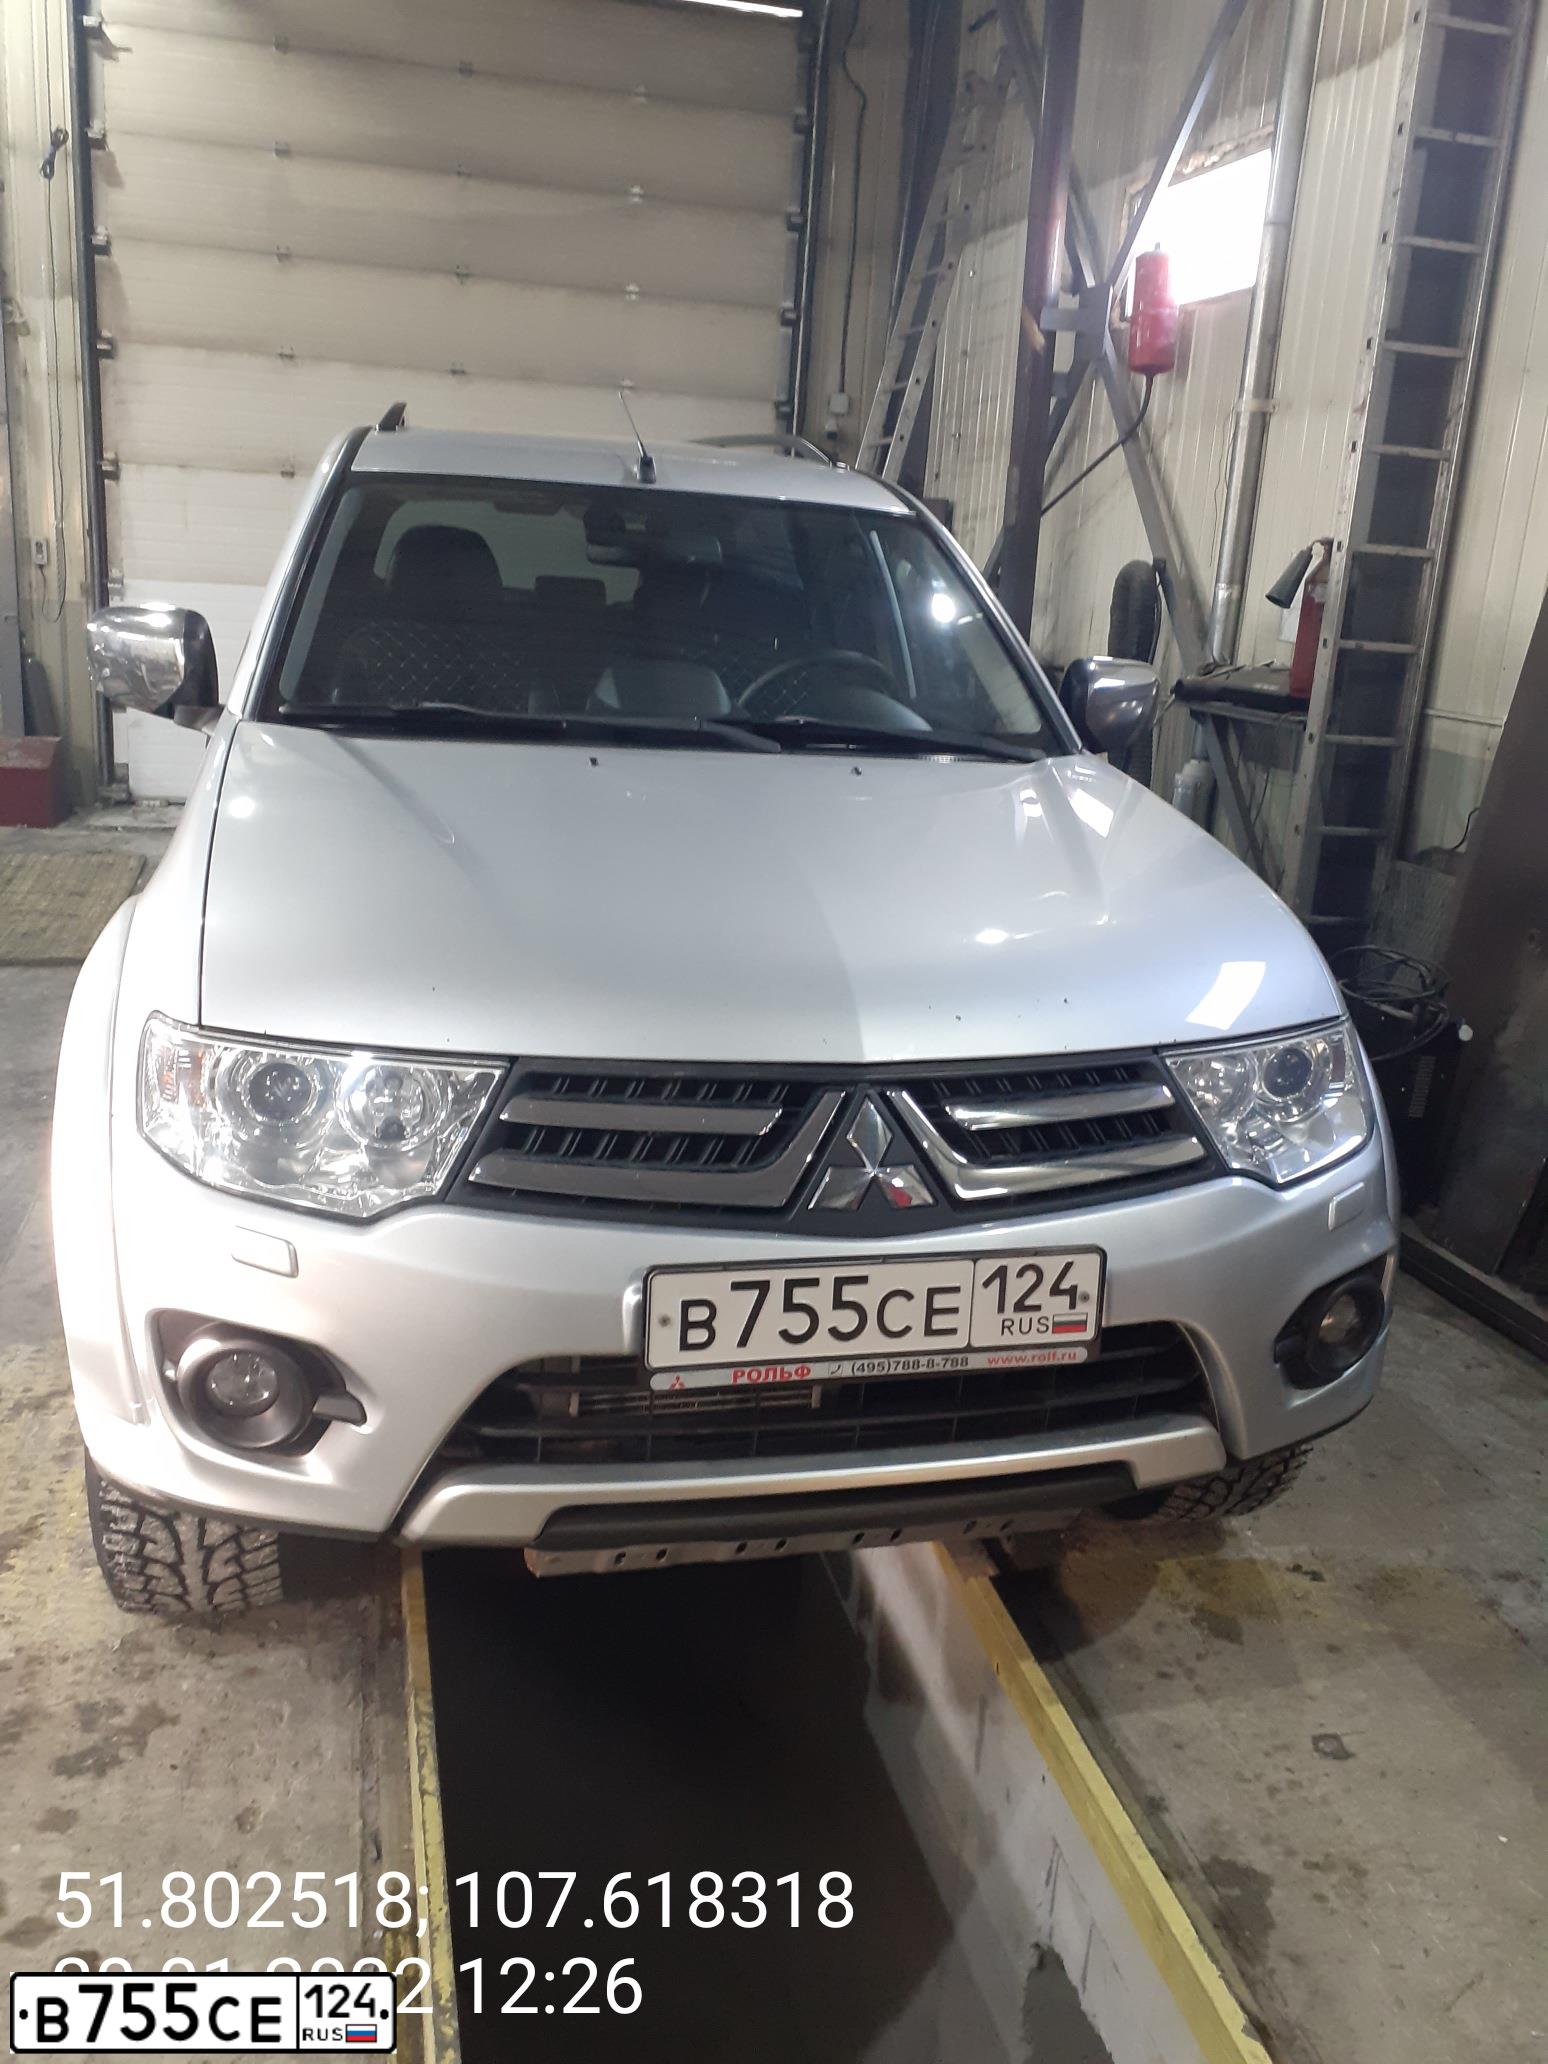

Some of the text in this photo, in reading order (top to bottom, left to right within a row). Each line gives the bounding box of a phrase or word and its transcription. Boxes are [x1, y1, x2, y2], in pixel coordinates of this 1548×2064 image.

[982, 1261, 1078, 1314] 124
[1001, 1316, 1050, 1336] RUS
[731, 1350, 1077, 1385] РОЛЬФ (495)788-8-788 www.rolf.ru
